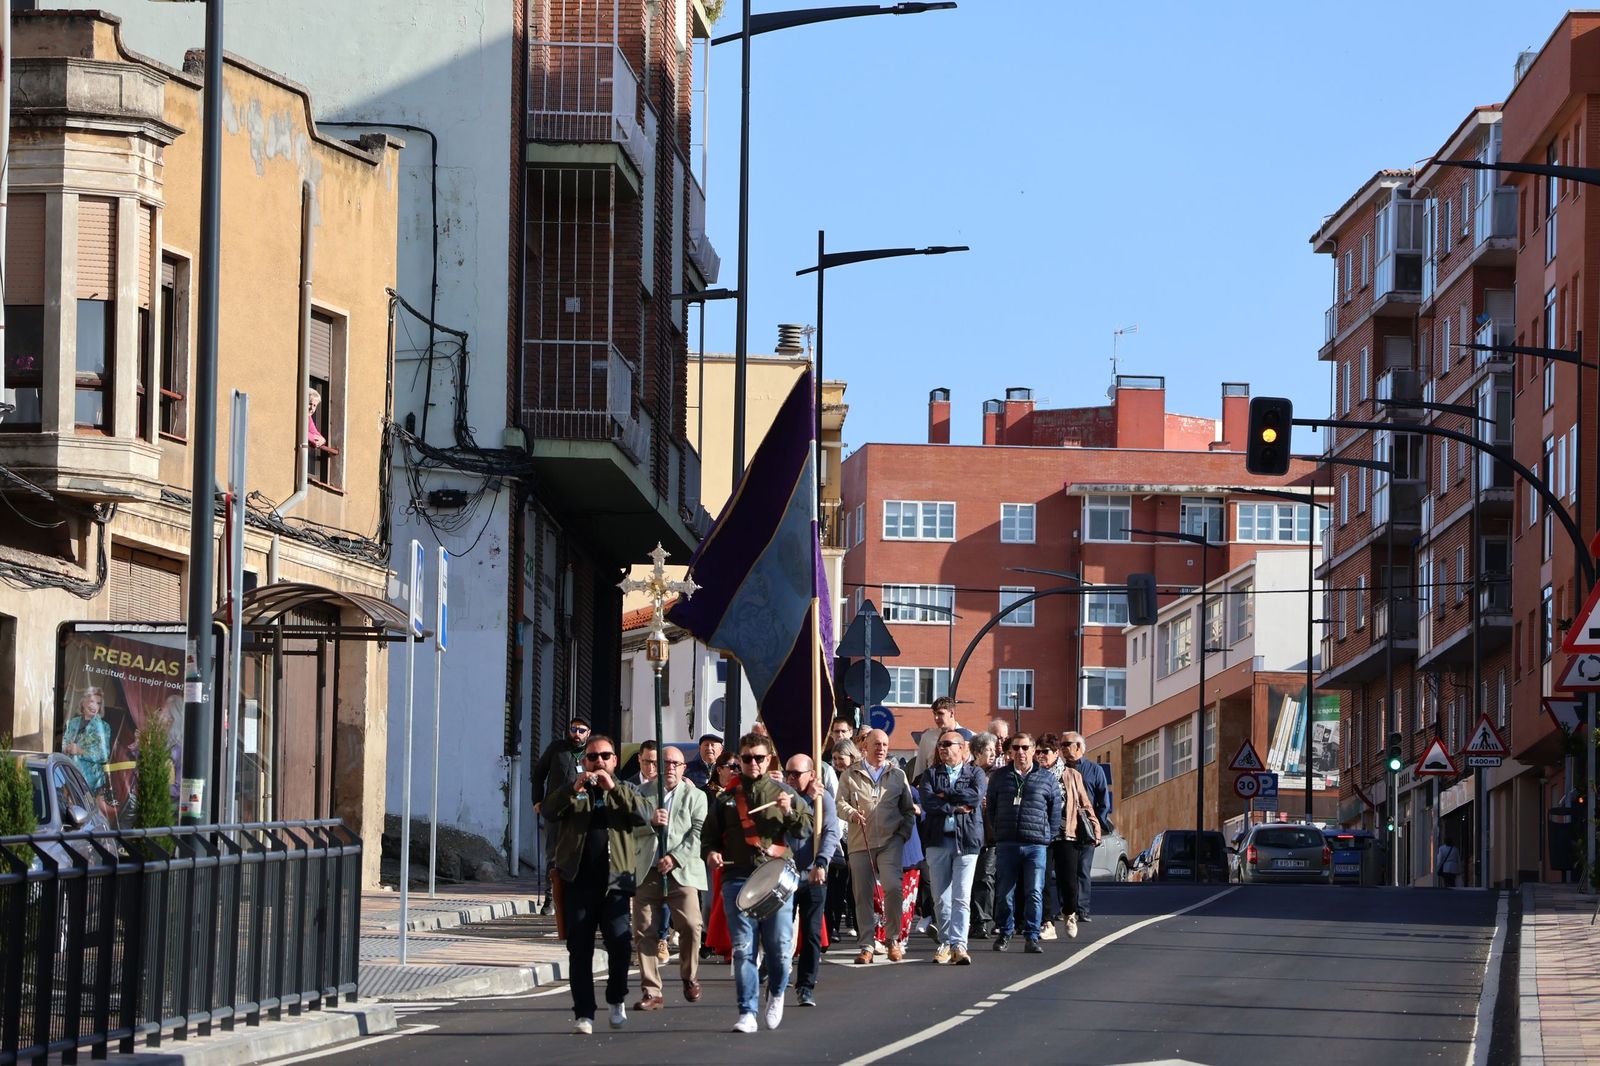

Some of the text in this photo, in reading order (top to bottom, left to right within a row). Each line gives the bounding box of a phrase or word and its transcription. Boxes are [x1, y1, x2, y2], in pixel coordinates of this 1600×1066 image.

[93, 645, 181, 677] REBAJAS
[95, 666, 127, 681] actitud,
[128, 673, 138, 682] tu
[139, 676, 163, 688] mejor
[163, 681, 185, 691] look!
[1239, 781, 1255, 791] 30
